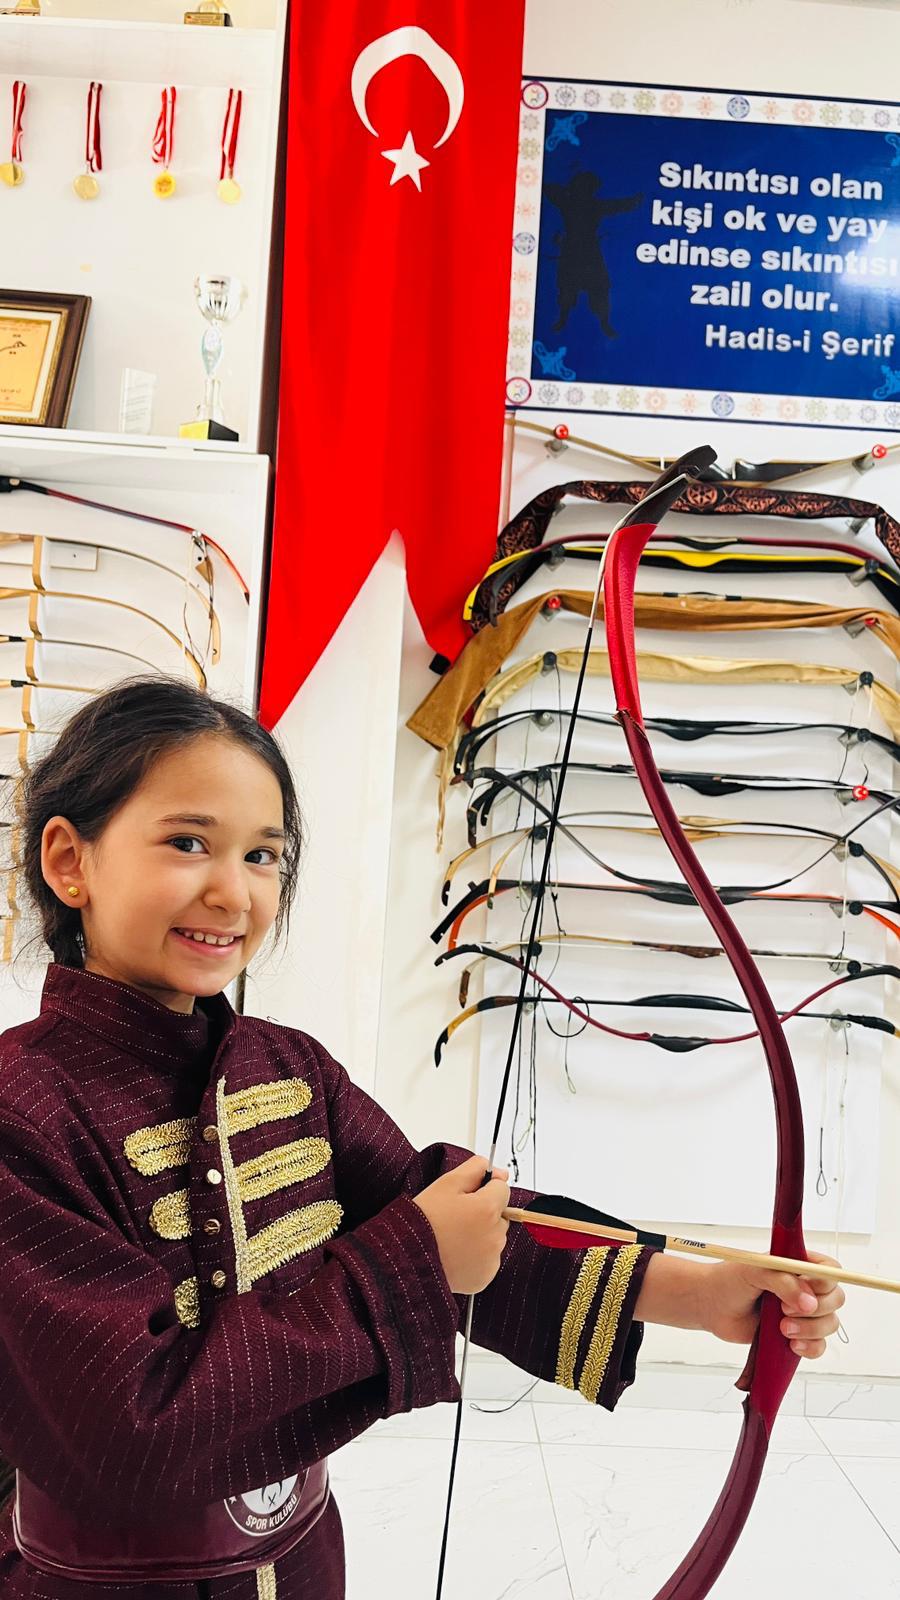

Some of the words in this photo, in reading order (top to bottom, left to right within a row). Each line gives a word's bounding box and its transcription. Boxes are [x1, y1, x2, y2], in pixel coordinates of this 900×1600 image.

[659, 161, 799, 195] Sıkıntısı
[810, 173, 883, 200] olan
[651, 199, 713, 233] kişi
[724, 205, 766, 231] ok
[776, 212, 817, 234] ve
[827, 215, 888, 243] yay
[636, 239, 751, 268] edinse
[761, 245, 899, 276] sıkıntısı
[690, 281, 751, 307] zail
[762, 283, 839, 312] olur.
[705, 324, 811, 352] Hadis-i
[822, 331, 895, 359] Şerif
[245, 1515, 267, 1529] SPOR
[269, 1494, 297, 1527] KULÜBÜ
